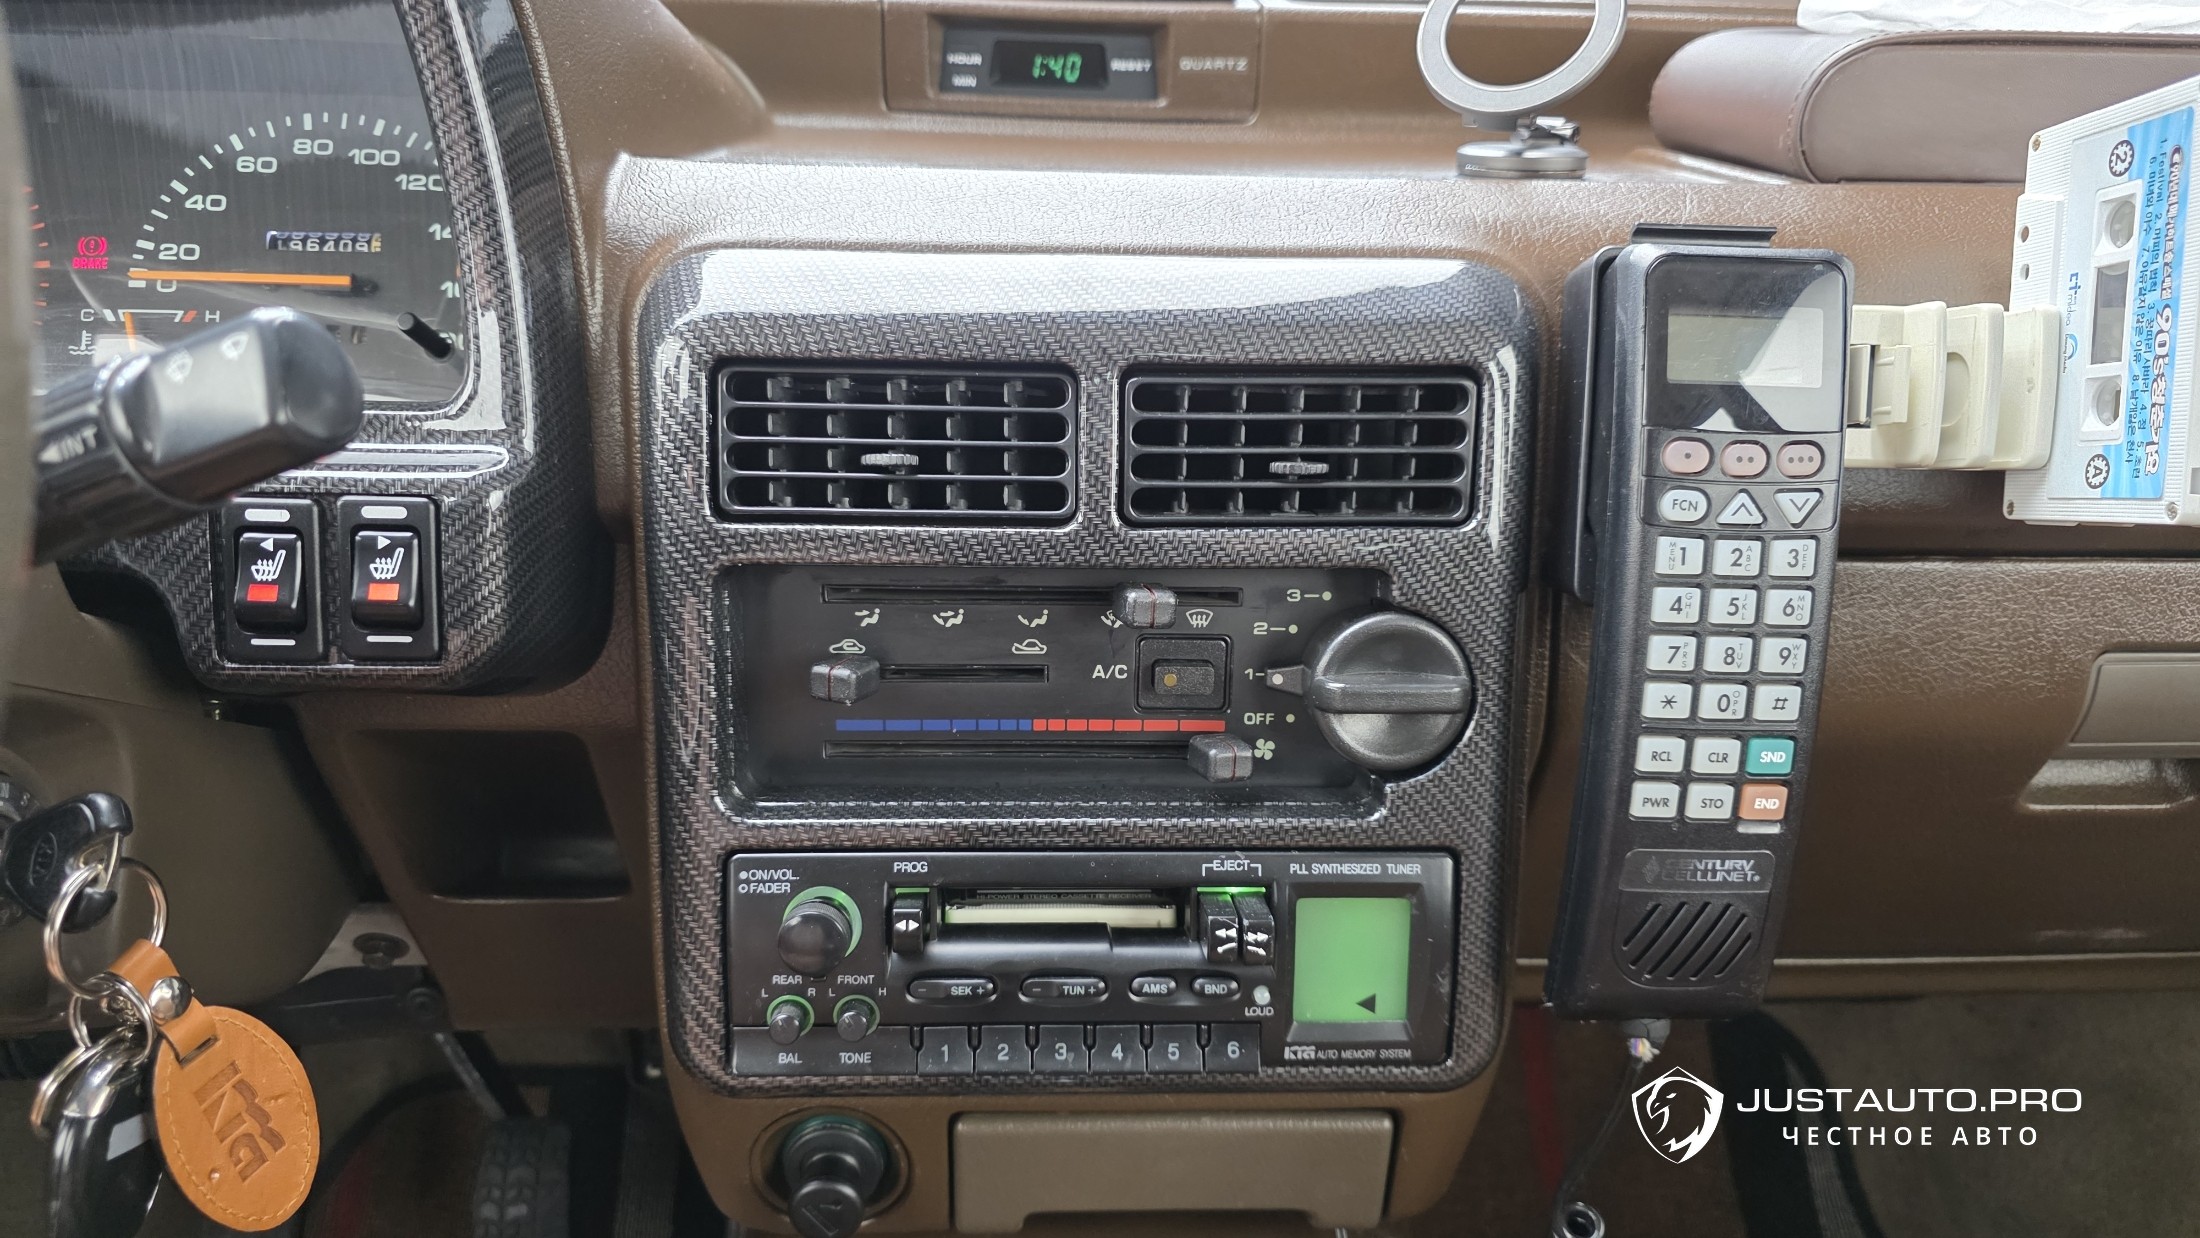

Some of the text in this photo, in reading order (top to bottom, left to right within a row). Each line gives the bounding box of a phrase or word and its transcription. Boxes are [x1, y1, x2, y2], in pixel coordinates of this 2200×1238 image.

[947, 52, 982, 66] HOUR
[1110, 58, 1152, 72] RESET
[1179, 56, 1248, 72] QUARTZ
[1032, 53, 1082, 83] 1:40
[952, 74, 977, 88] MIN
[293, 138, 333, 156] 80
[348, 149, 400, 166] 100
[2115, 150, 2129, 167] 2
[236, 157, 278, 173] 60
[2155, 151, 2166, 202] Festival
[185, 195, 227, 211] 40
[158, 244, 200, 261] 20
[72, 257, 108, 269] BRAKE
[80, 309, 94, 323] C
[206, 310, 220, 323] H
[2091, 464, 2104, 480] A
[1672, 499, 1699, 512] FCN
[1679, 547, 1687, 566] 1
[1730, 547, 1743, 567] 2
[1787, 548, 1799, 568] 3
[1286, 589, 1301, 601] 3
[1669, 595, 1683, 615] 4
[1726, 597, 1740, 616] 5
[1782, 598, 1795, 617] 6
[1253, 622, 1268, 634] 2
[1667, 645, 1681, 664] 7
[1723, 646, 1736, 666] 8
[1779, 647, 1792, 666] 9
[1092, 664, 1128, 679] A/C
[1244, 669, 1253, 680] 1
[1717, 694, 1731, 713] 0
[1243, 713, 1275, 725] OFF
[1651, 751, 1672, 762] RCL
[1708, 752, 1729, 763] CLR
[1760, 752, 1786, 763] SND
[1642, 798, 1670, 808] PWR
[1700, 798, 1724, 809] STO
[1754, 798, 1780, 809] END
[894, 861, 928, 873] PROG
[1213, 860, 1251, 871] EJECT
[1290, 863, 1421, 875] PLL SYNTHESIZED TUNER
[750, 883, 791, 894] FADER
[772, 975, 802, 985] REAR
[838, 975, 875, 985] FRONT
[761, 988, 769, 998] L
[808, 988, 816, 997] R
[829, 988, 836, 997] L
[879, 987, 887, 996] H
[1142, 983, 1168, 994] AMS
[1204, 984, 1228, 994] BND
[1245, 1007, 1274, 1016] LOUD
[941, 1045, 950, 1062] 1
[997, 1044, 1009, 1060] 2
[1055, 1043, 1067, 1060] 3
[1111, 1043, 1124, 1060] 4
[1167, 1043, 1180, 1060] 5
[1227, 1042, 1240, 1058] 6
[1316, 1049, 1339, 1059] AUTO
[1340, 1049, 1377, 1059] MEMORY
[1379, 1048, 1412, 1059] SYSTEM
[778, 1053, 802, 1064] BAL
[839, 1052, 872, 1064] TONE
